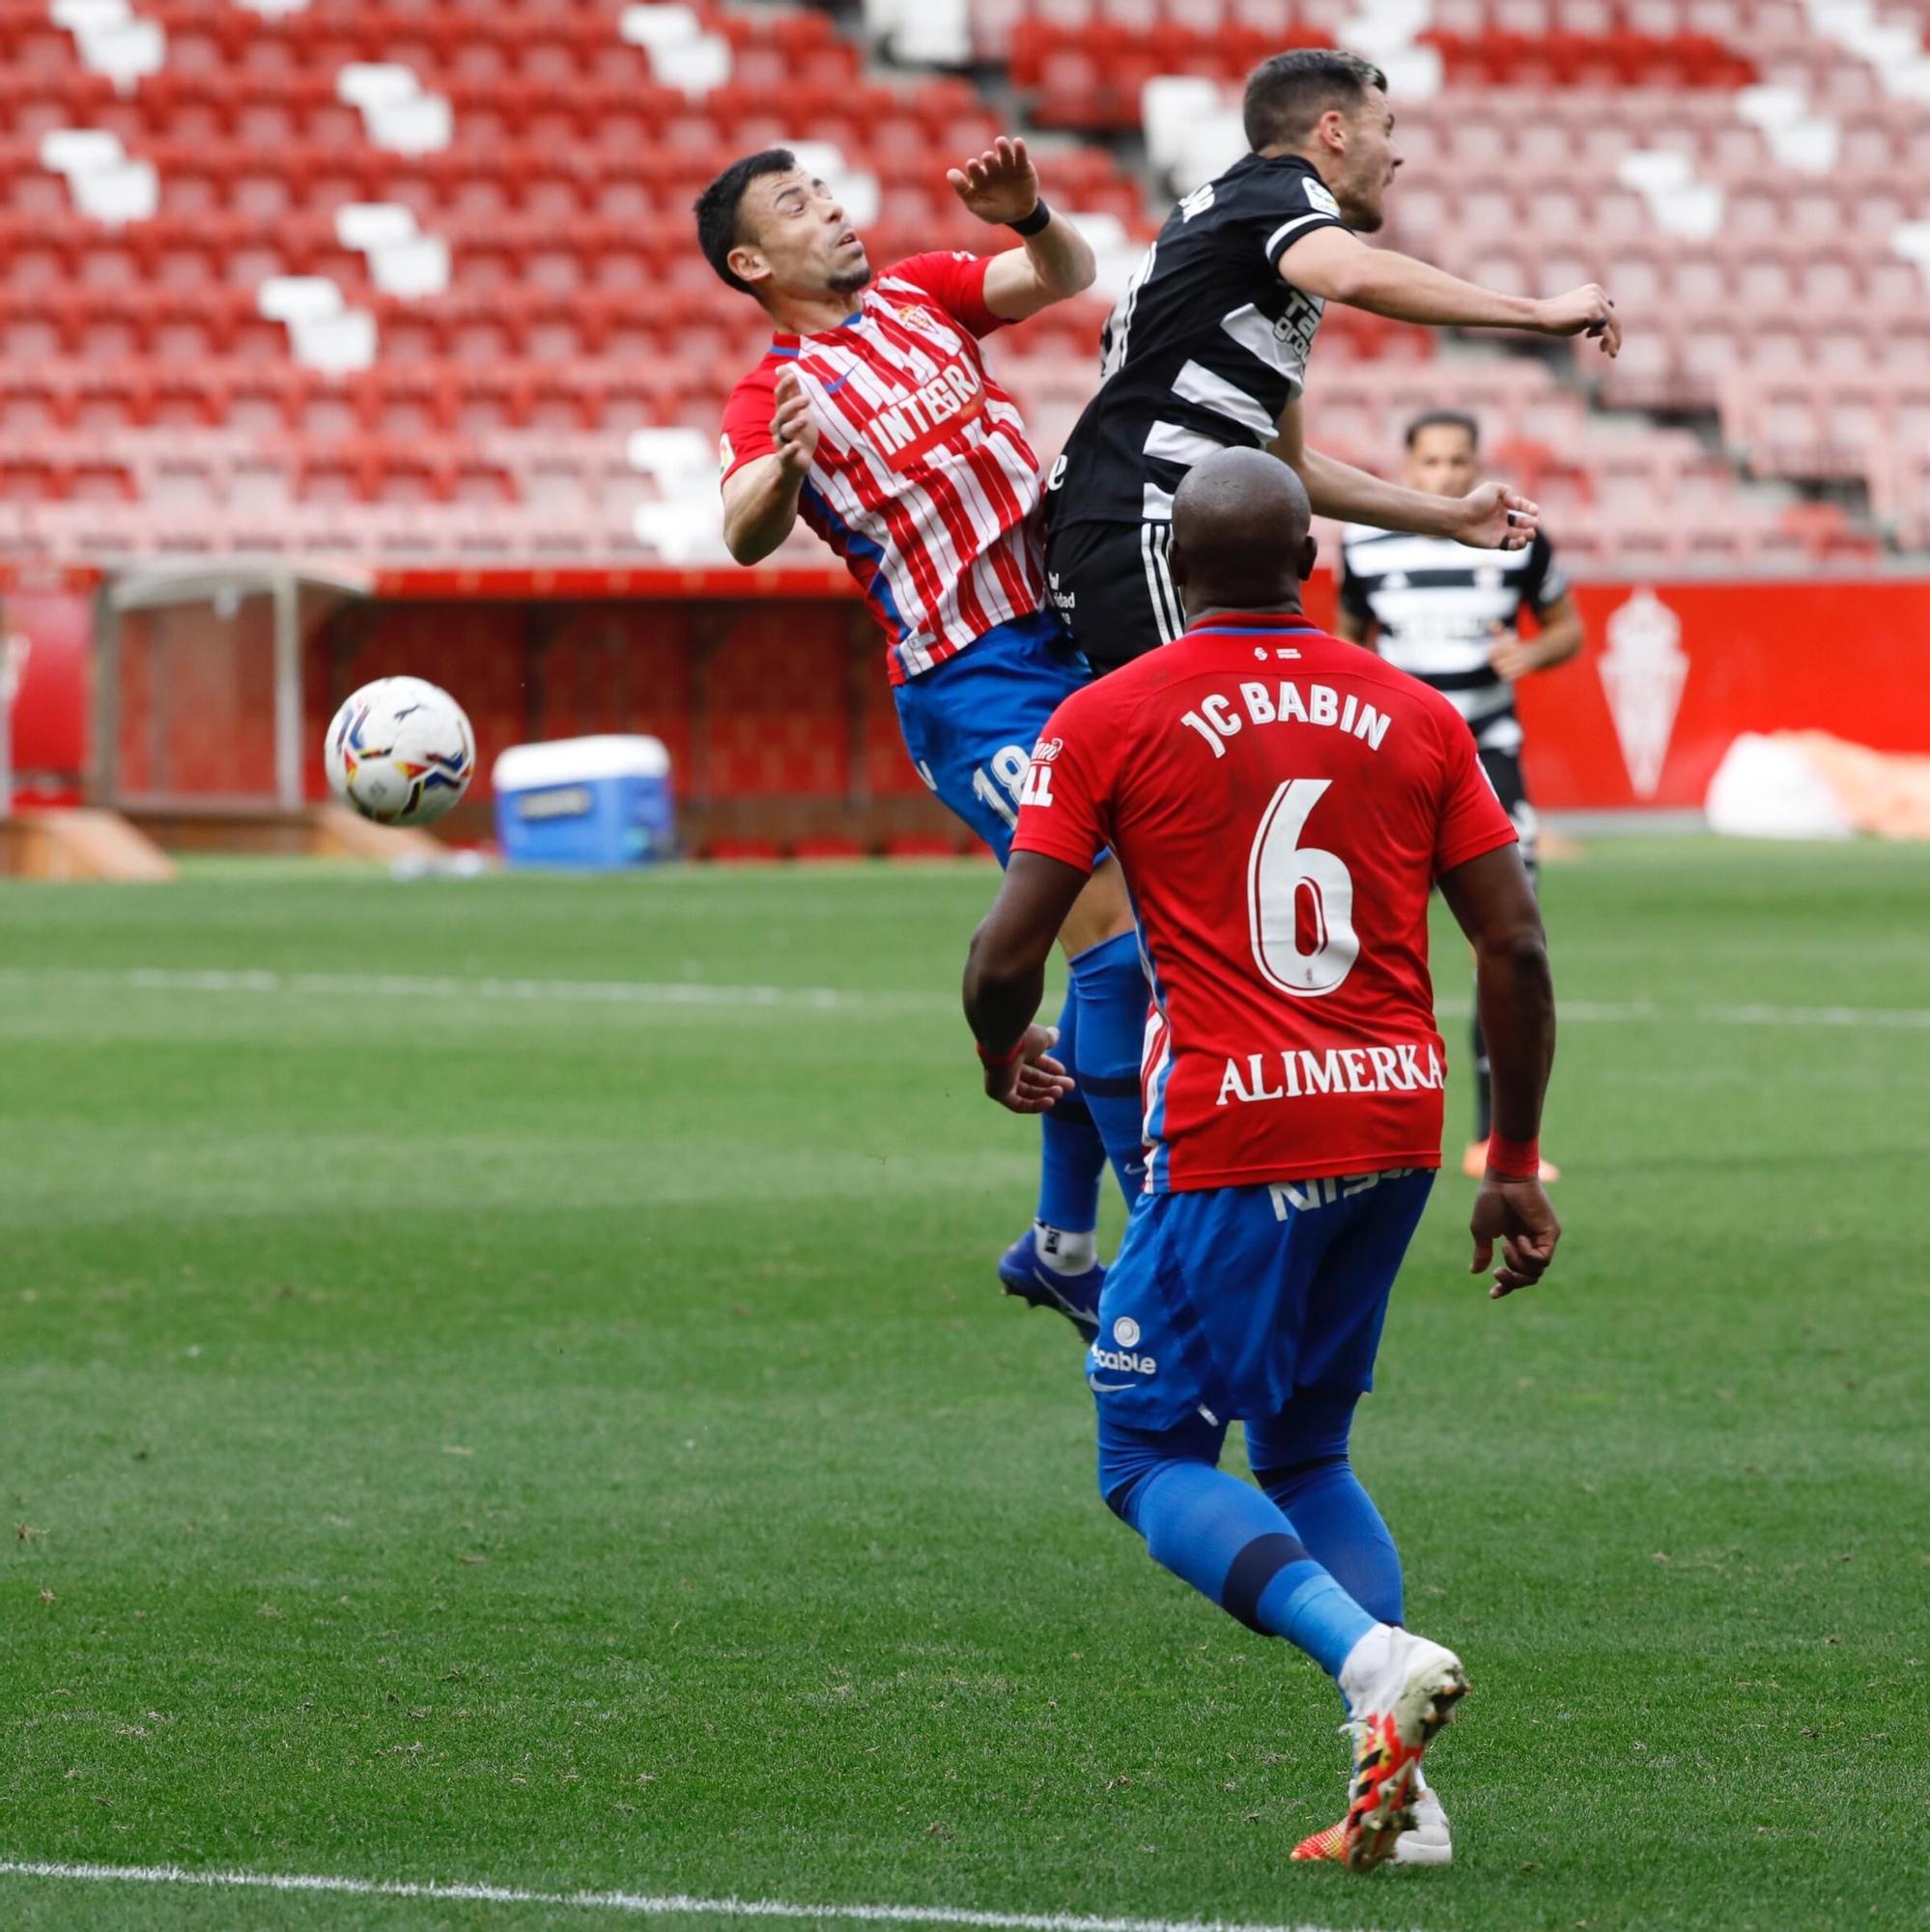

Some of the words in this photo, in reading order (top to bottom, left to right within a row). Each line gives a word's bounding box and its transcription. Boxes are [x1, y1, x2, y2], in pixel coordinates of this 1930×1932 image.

[1180, 694, 1242, 758] JC
[1239, 681, 1392, 752] BABIN
[973, 745, 1033, 831] 18
[1247, 779, 1360, 997] 6
[1215, 1043, 1445, 1105] ALIMERKA
